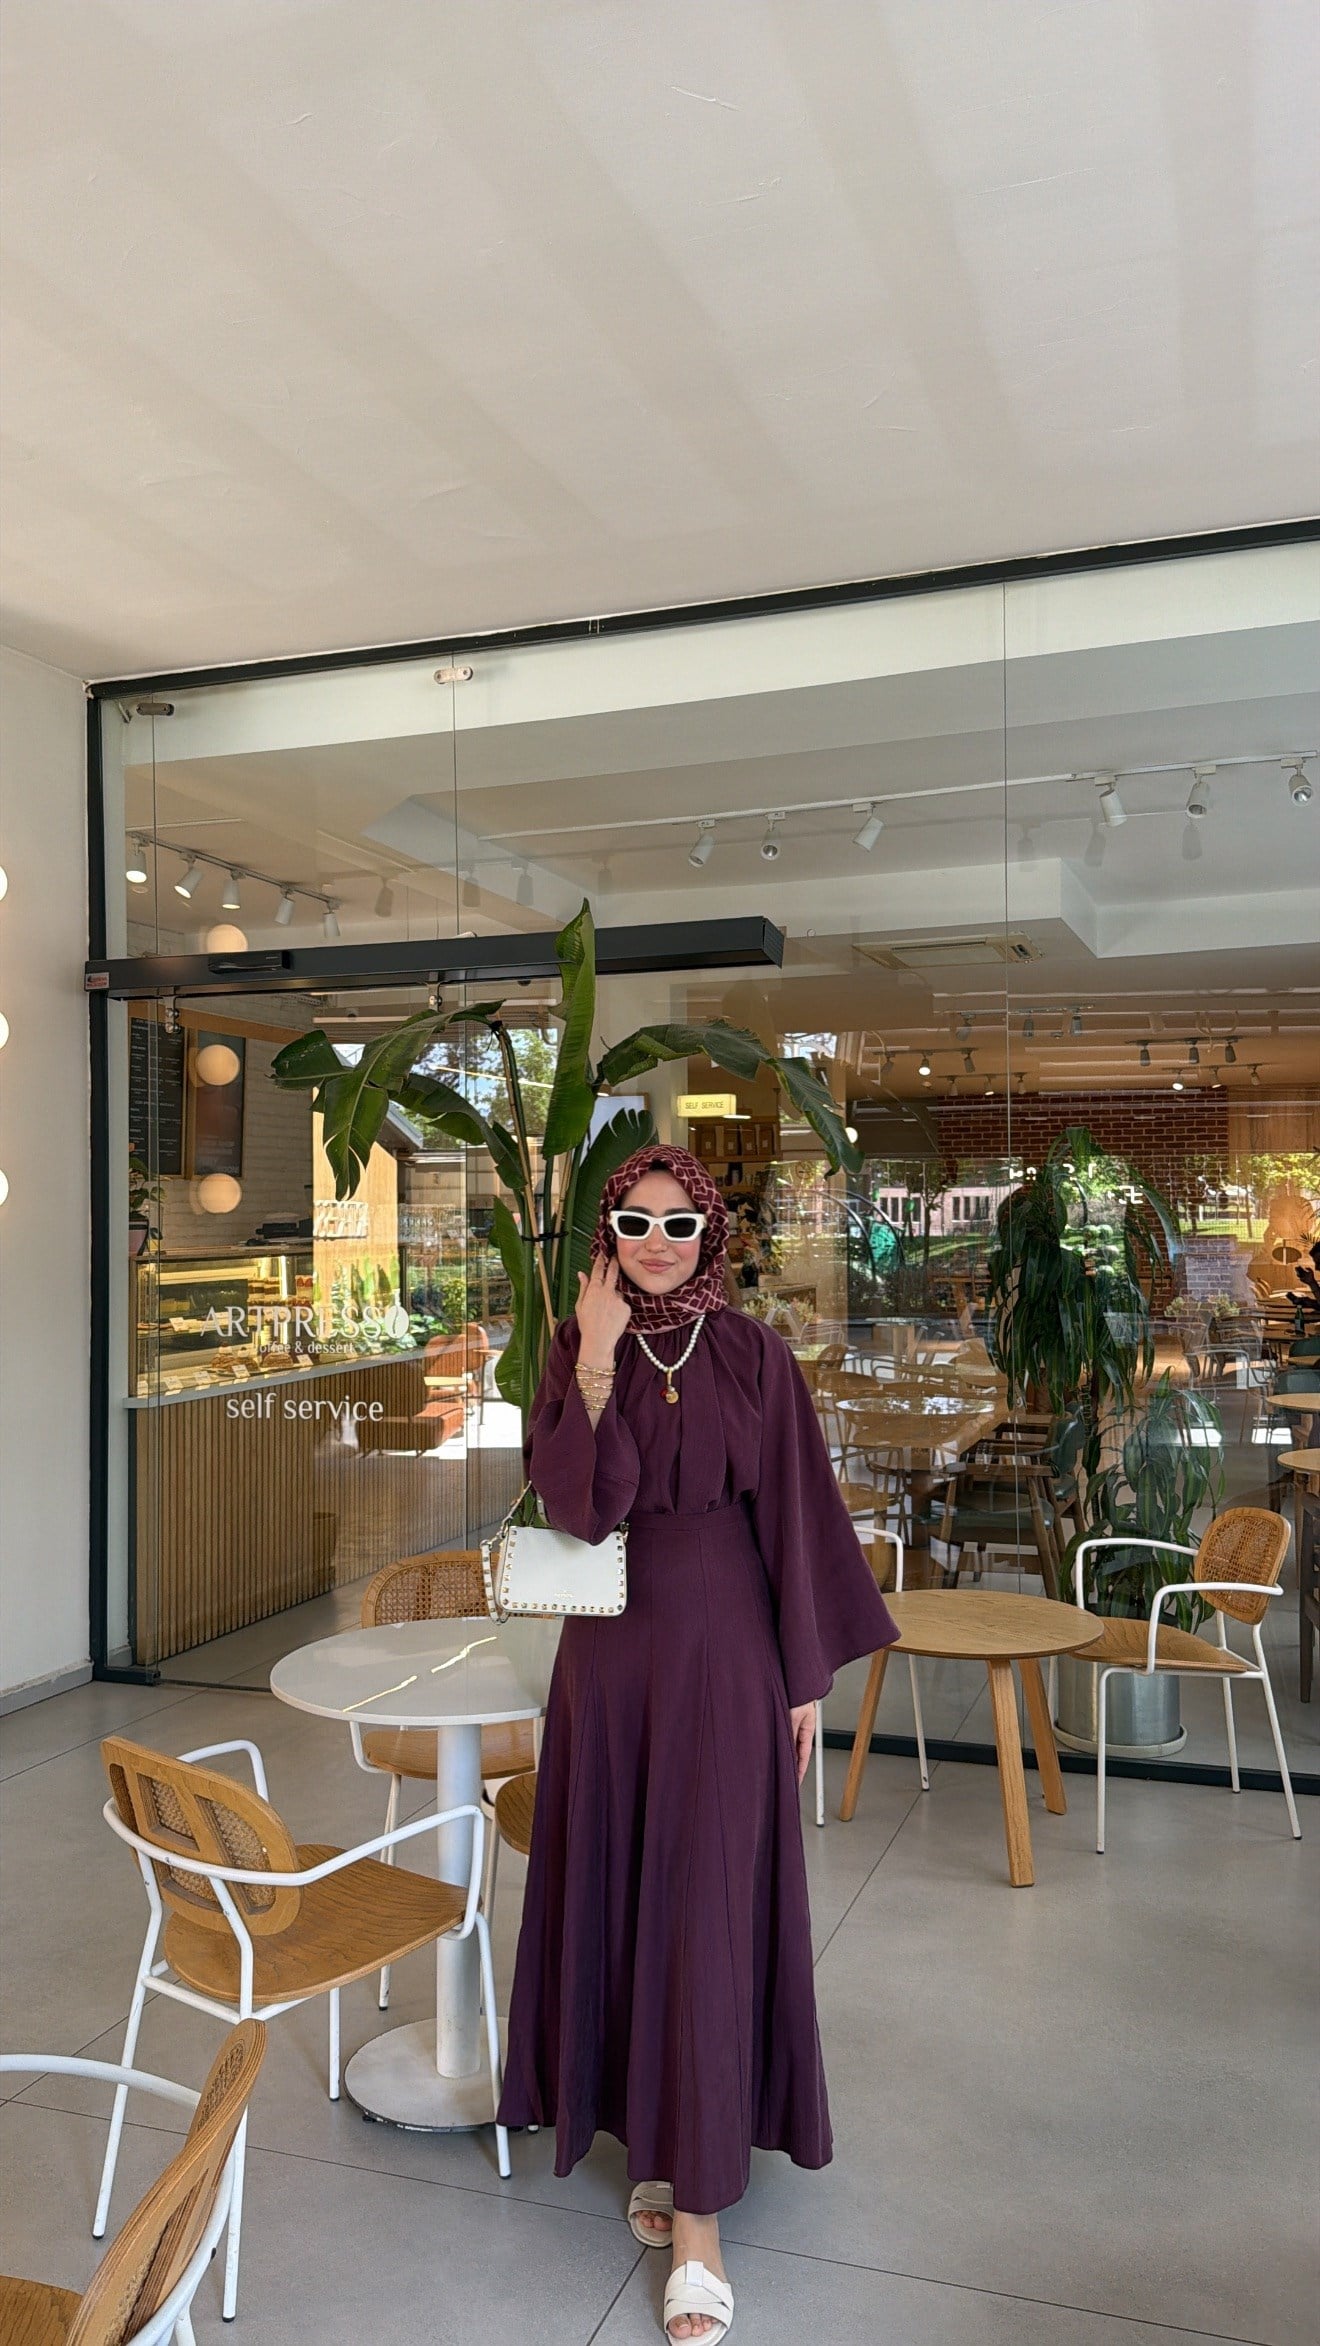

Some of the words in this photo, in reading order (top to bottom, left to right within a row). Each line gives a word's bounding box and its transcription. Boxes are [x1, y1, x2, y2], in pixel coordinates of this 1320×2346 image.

[701, 1101, 725, 1109] SERVICE
[255, 1340, 291, 1354] offee
[294, 1340, 303, 1354] &
[307, 1340, 356, 1354] dessert
[226, 1392, 278, 1420] self
[283, 1394, 385, 1422] service
